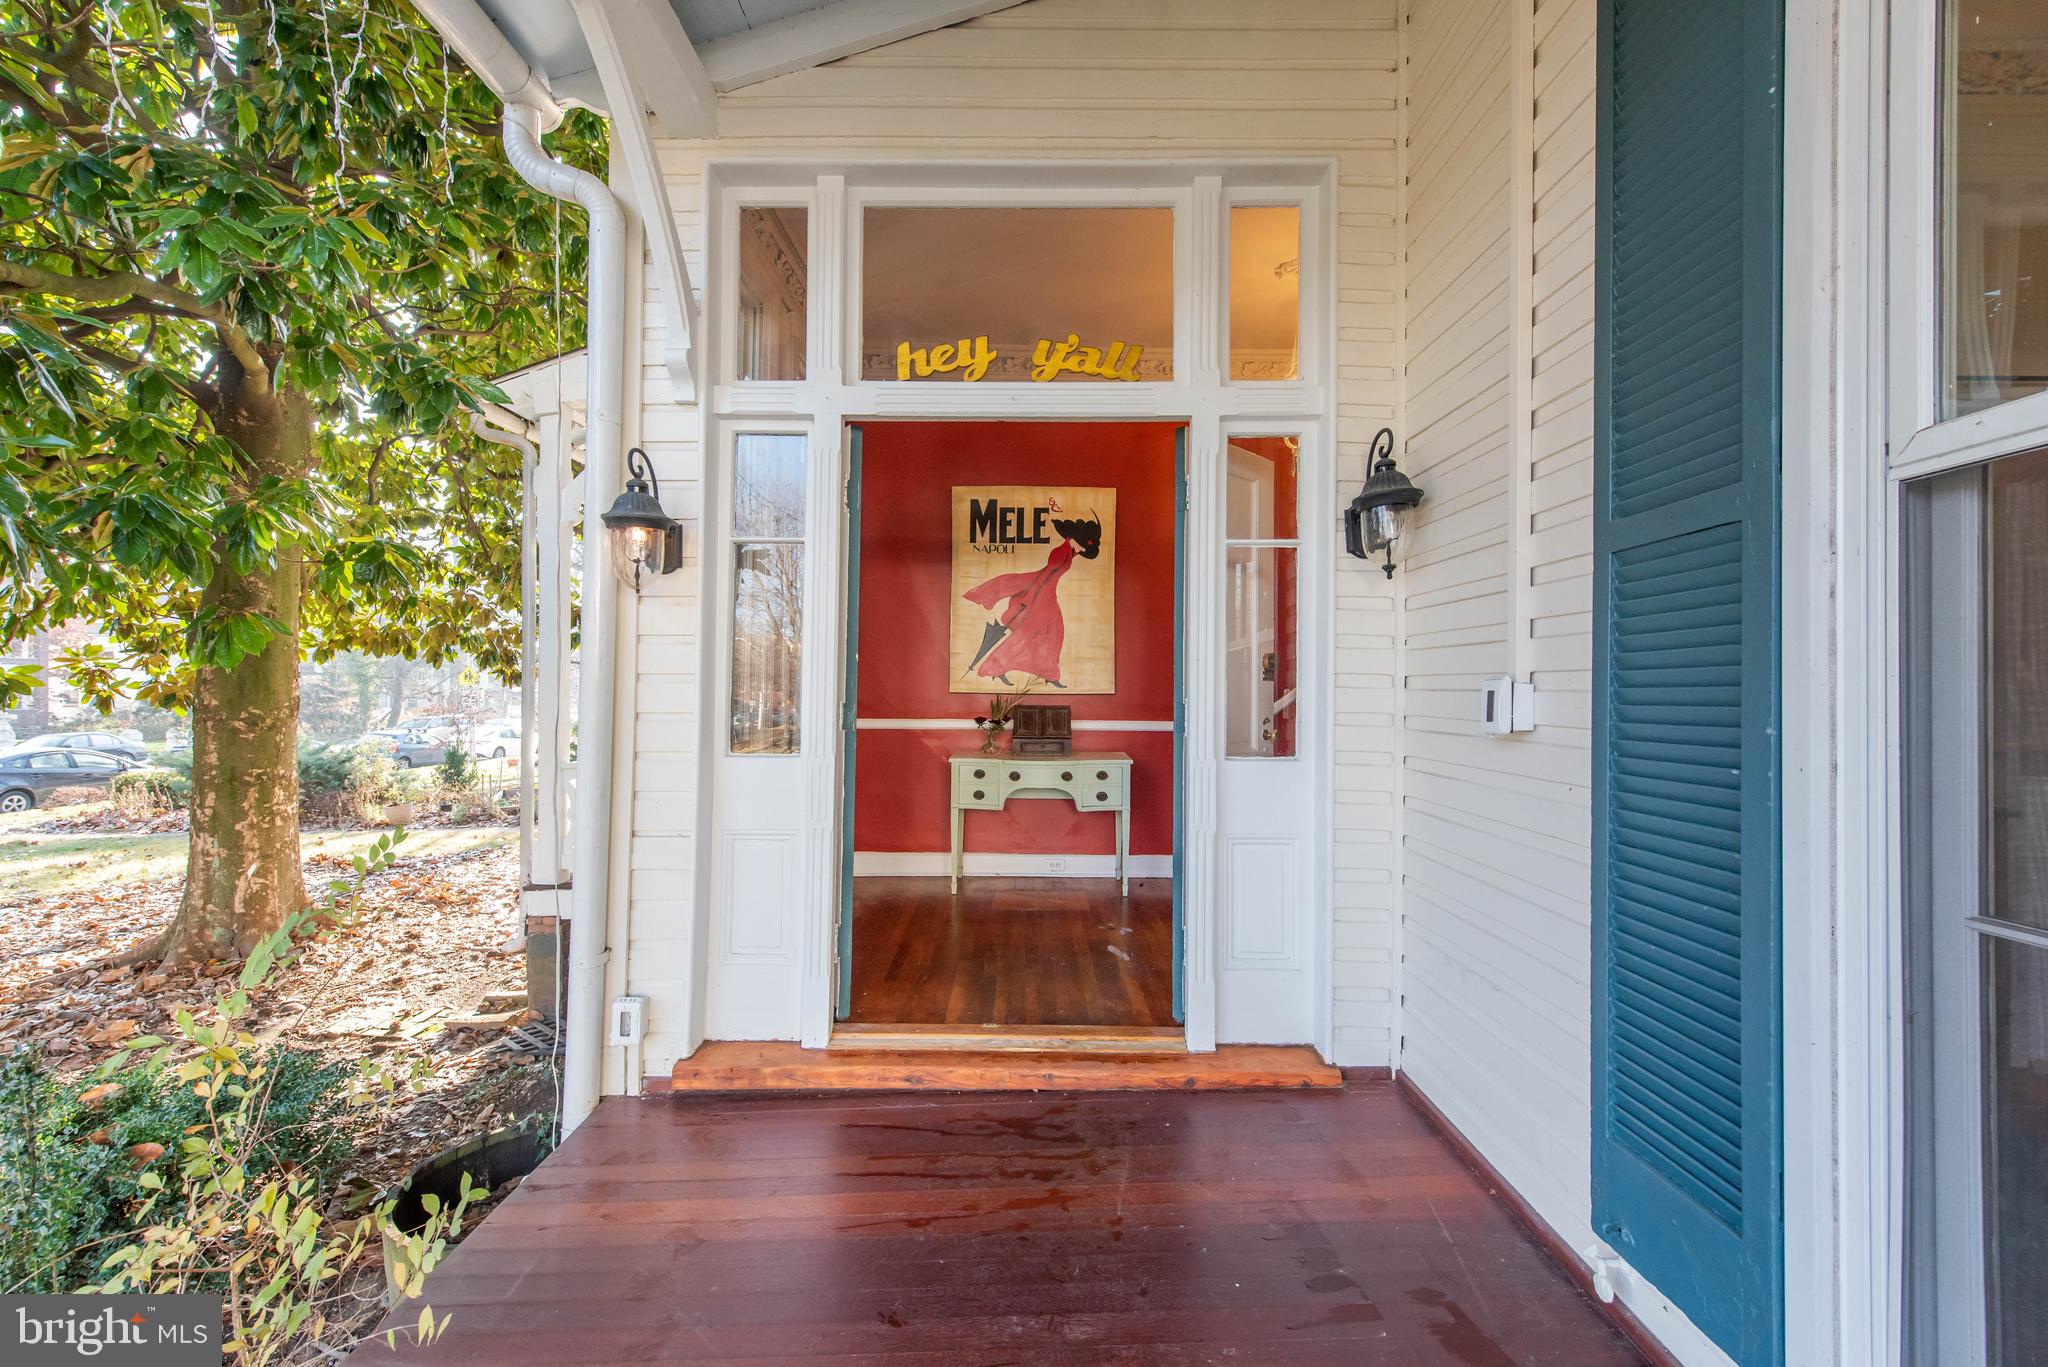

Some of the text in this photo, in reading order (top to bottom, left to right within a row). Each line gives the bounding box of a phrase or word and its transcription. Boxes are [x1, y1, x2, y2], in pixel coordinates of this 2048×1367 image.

[896, 333, 1144, 382] hey y'all
[970, 499, 1050, 543] MELE
[972, 544, 1015, 554] NAPOLI
